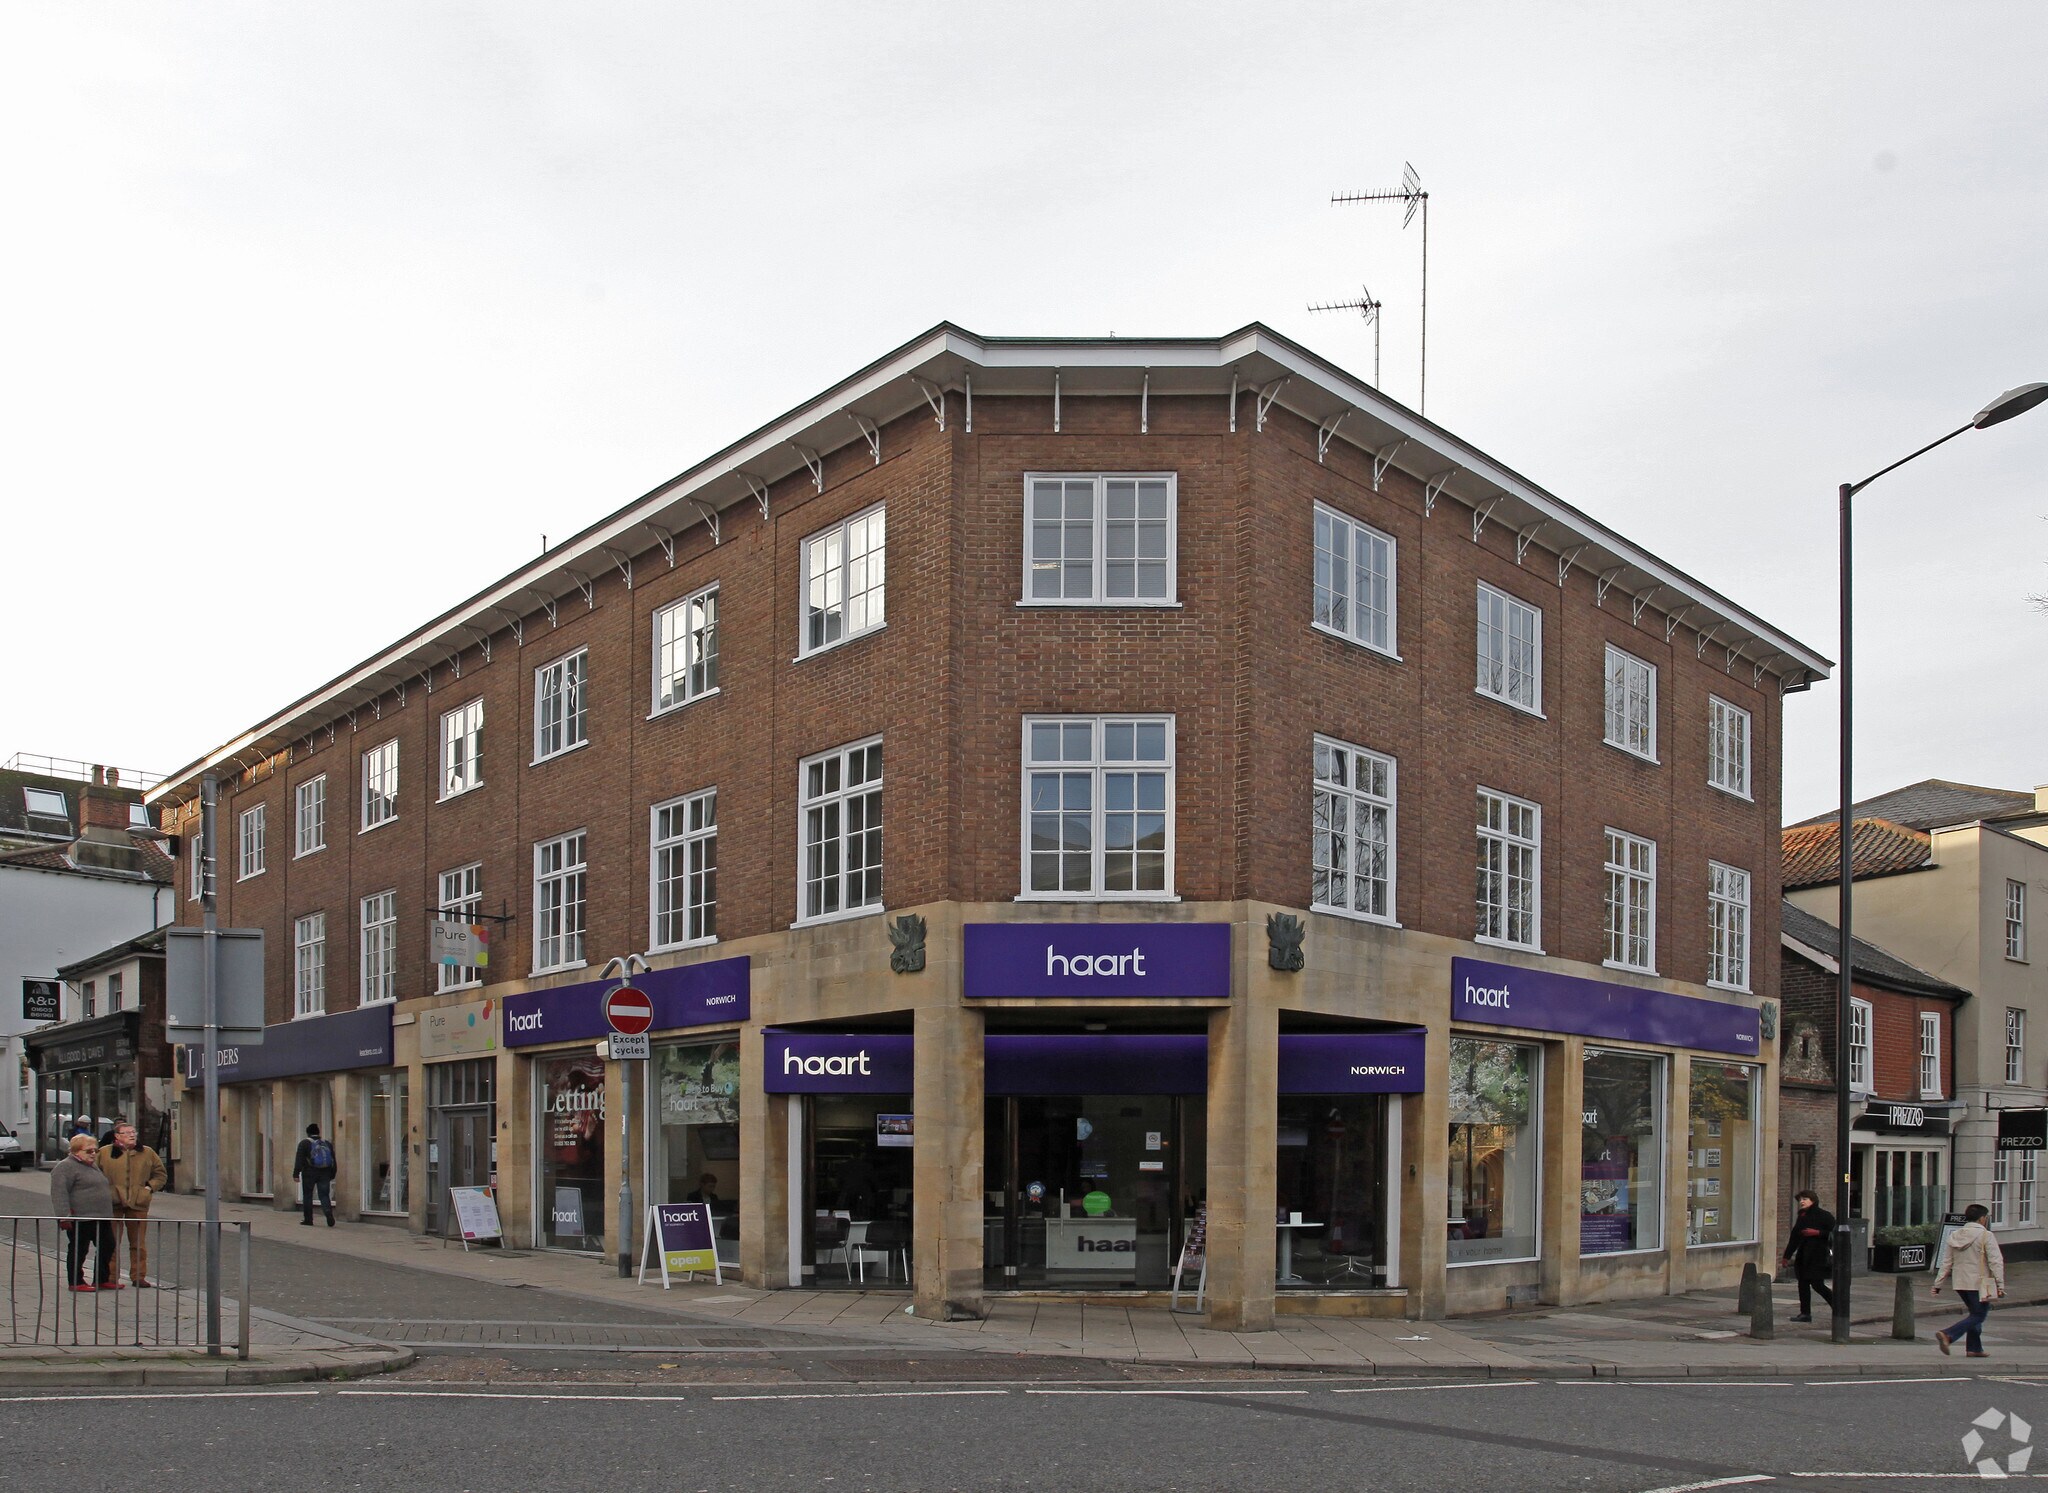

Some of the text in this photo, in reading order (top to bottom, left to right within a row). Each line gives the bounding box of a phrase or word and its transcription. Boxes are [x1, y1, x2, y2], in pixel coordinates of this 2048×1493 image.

[435, 926, 467, 941] Pure
[1047, 945, 1146, 976] haart
[1466, 977, 1510, 1009] haart
[27, 996, 57, 1006] A&D
[706, 995, 736, 1006] NORWICH
[429, 1015, 446, 1028] Pure
[509, 1008, 543, 1032] haart
[613, 1035, 645, 1045] Except
[1735, 1033, 1754, 1042] NORWICH
[614, 1046, 645, 1056] cycles
[784, 1047, 871, 1075] haart
[1351, 1066, 1405, 1075] NORWICH
[710, 1083, 724, 1095] Buy
[670, 1095, 699, 1112] haart
[1892, 1106, 1924, 1127] PREZZO
[2001, 1136, 2043, 1147] PREZZO
[551, 1206, 578, 1223] haart
[663, 1209, 700, 1223] haart
[669, 1256, 701, 1268] open
[1901, 1249, 1924, 1264] PREZZO
